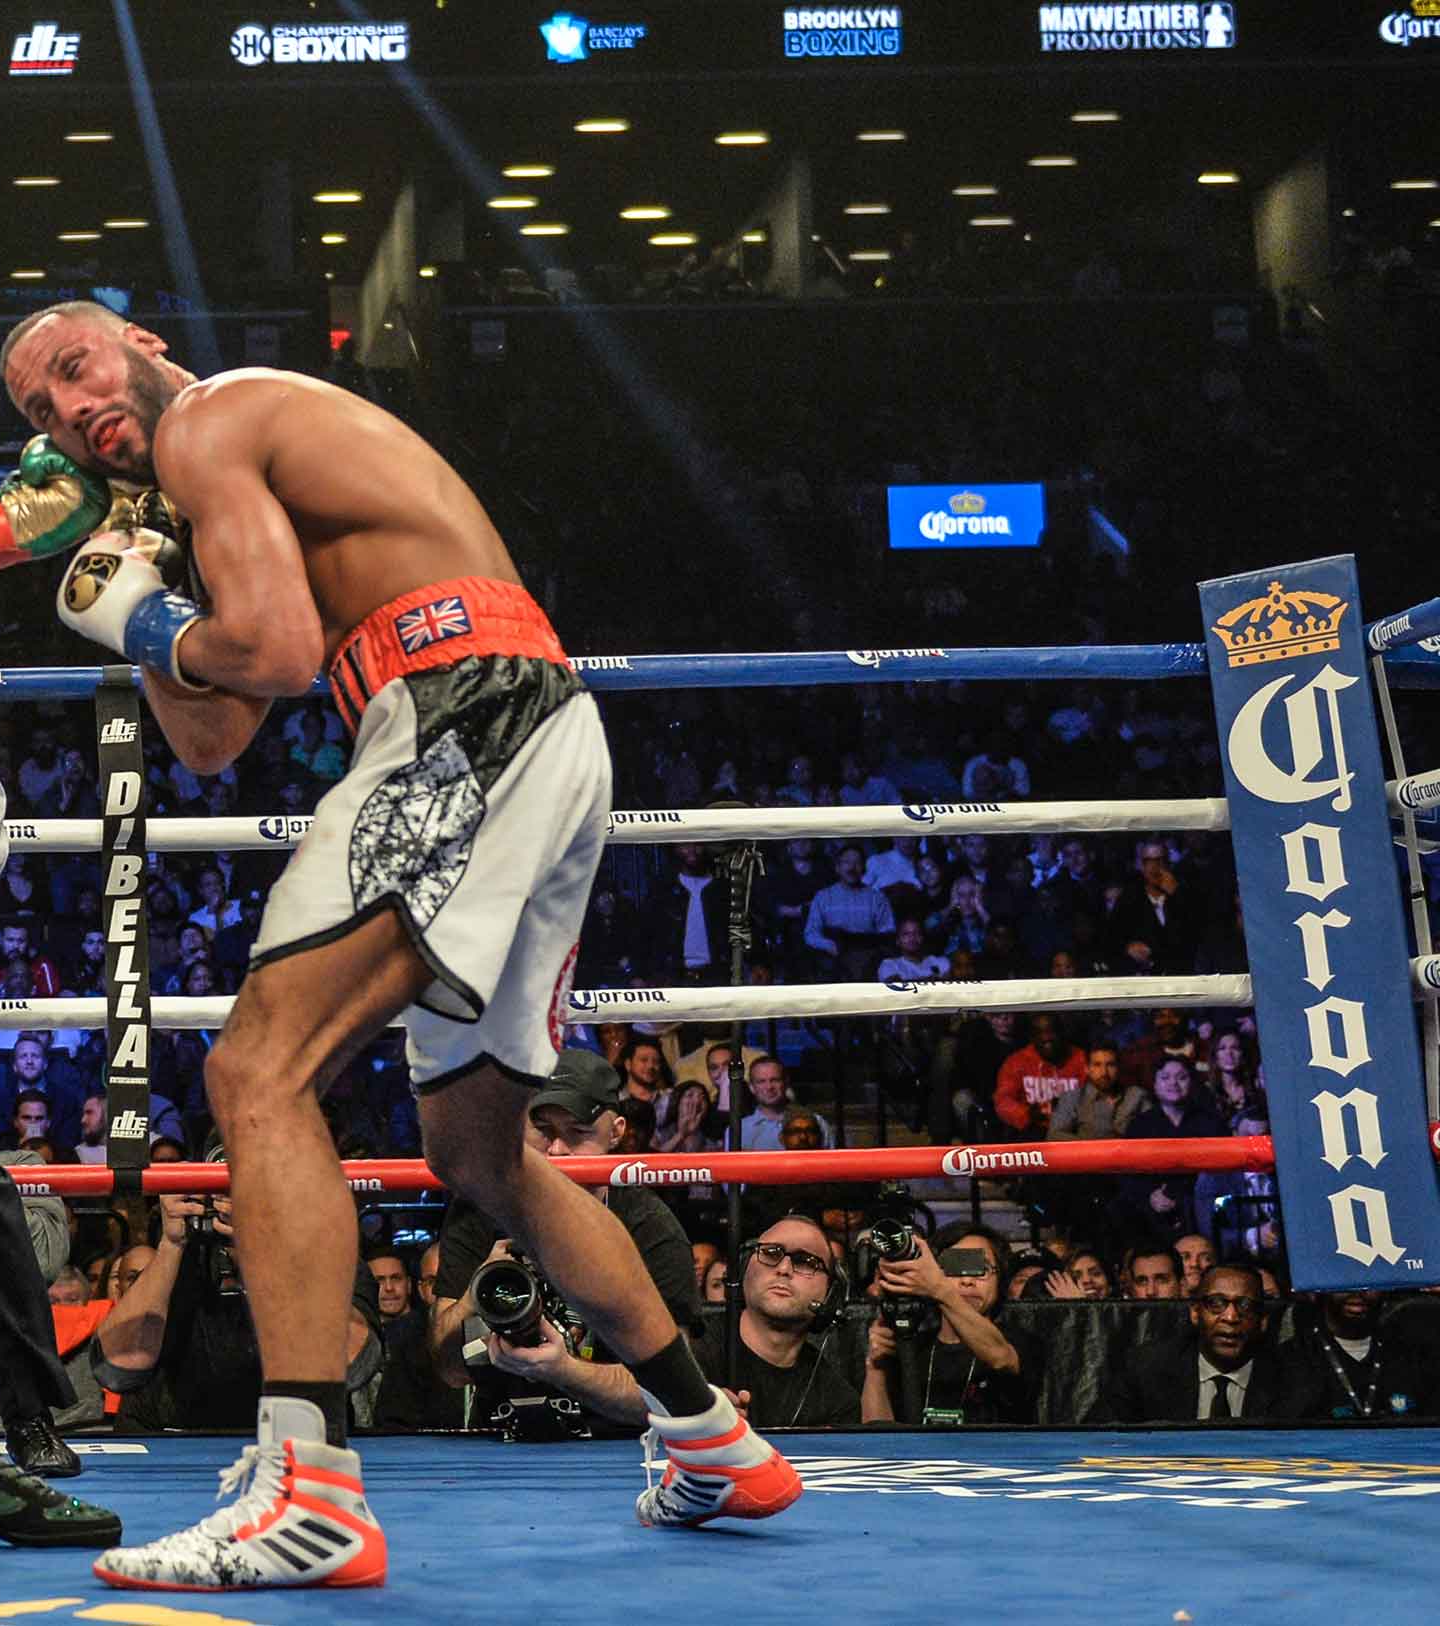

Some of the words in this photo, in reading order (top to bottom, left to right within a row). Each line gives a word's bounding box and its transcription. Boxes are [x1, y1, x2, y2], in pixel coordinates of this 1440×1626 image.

[784, 10, 899, 30] BROOKLYN
[1040, 4, 1199, 31] MAYWEATHER
[272, 25, 405, 38] CHAMPIONSHIP
[784, 31, 900, 57] BOXING
[1040, 31, 1201, 51] PROMOTIONS
[272, 38, 408, 62] BOXING
[920, 511, 1012, 542] Corona
[105, 771, 148, 1068] DIBELLA
[1228, 664, 1407, 1267] Corona
[569, 988, 670, 1013] Corona
[610, 1161, 713, 1187] Corona
[942, 1147, 1047, 1176] Corona
